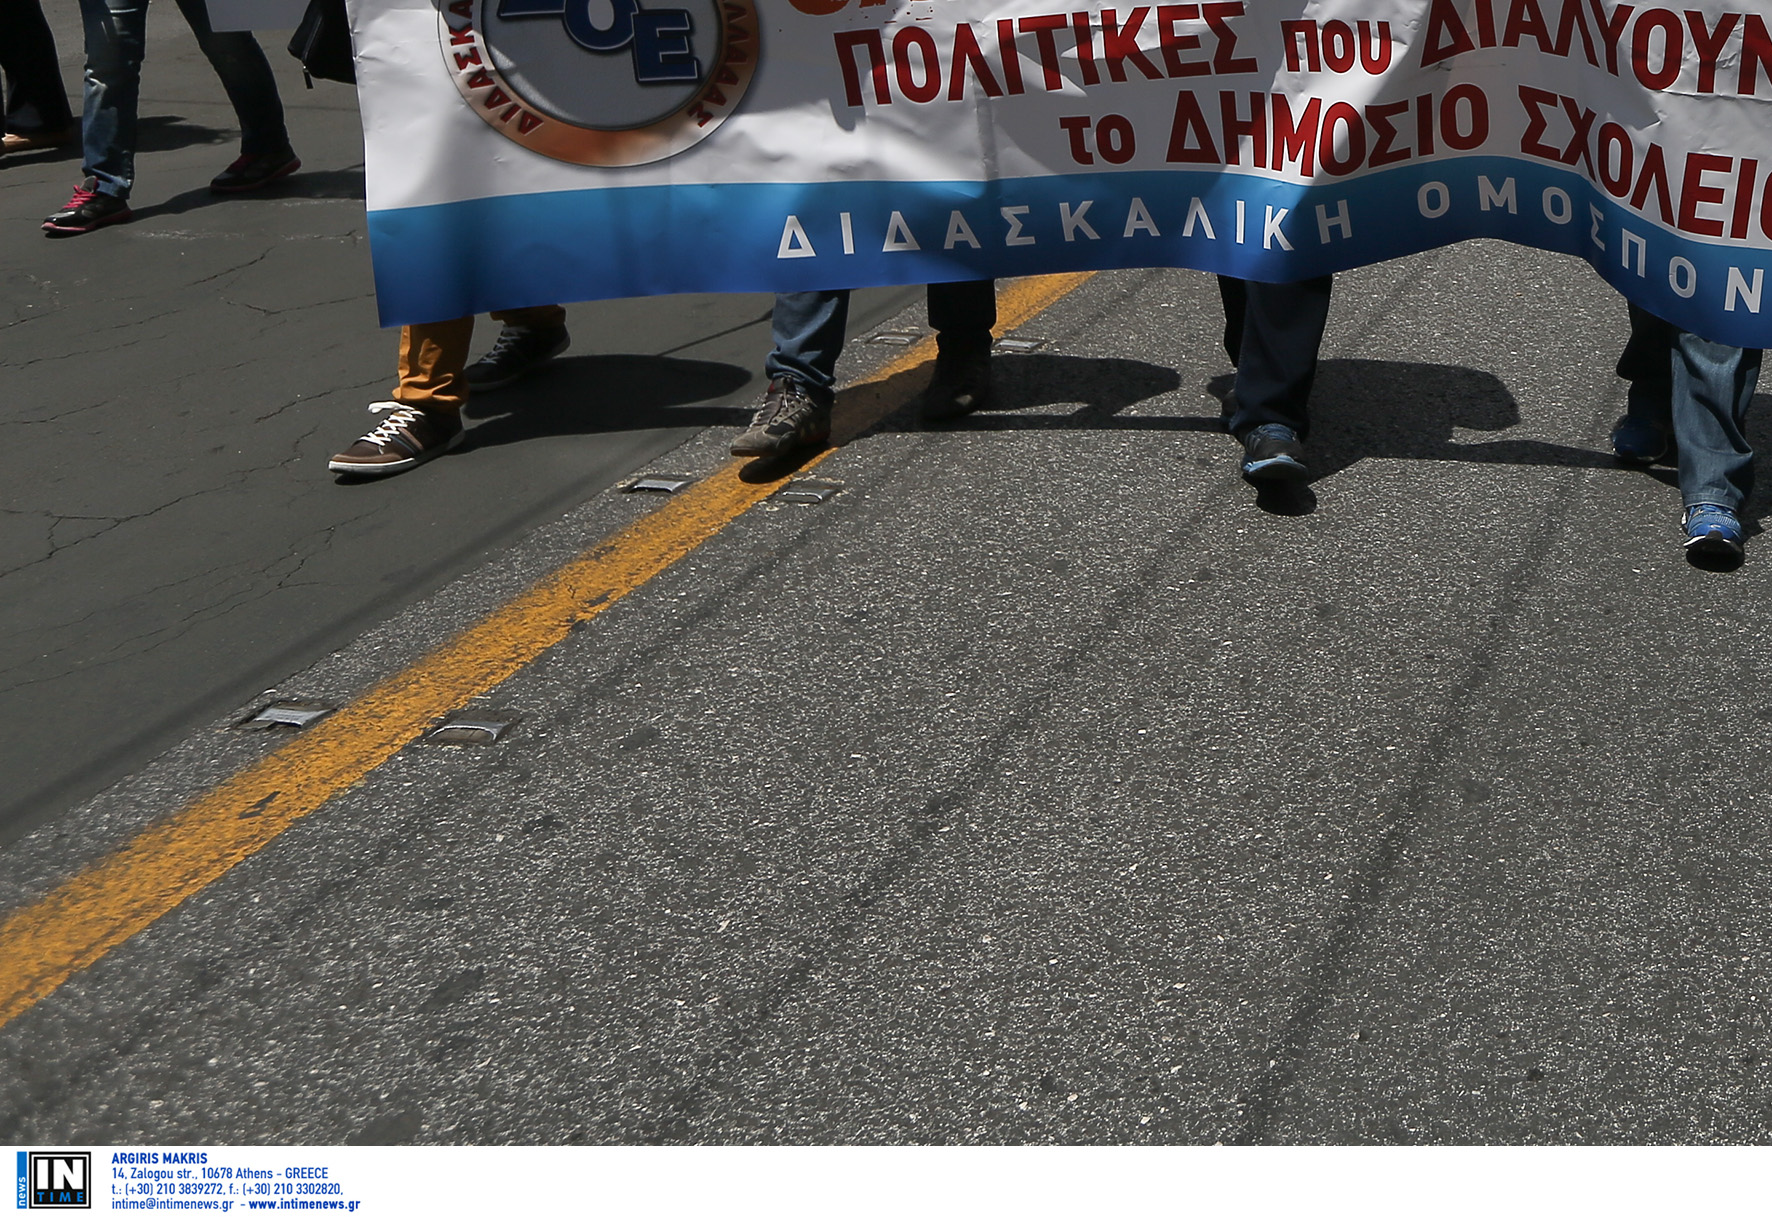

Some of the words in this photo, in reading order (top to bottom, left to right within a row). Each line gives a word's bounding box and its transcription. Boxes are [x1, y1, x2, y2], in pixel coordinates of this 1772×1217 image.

[834, 1, 1257, 107] ΠΟΛΙΤΙΚΕΣ
[1281, 18, 1393, 76] που
[1060, 114, 1136, 165] το
[1166, 83, 1490, 177] ΔΗΜΟΣΙΟ
[776, 195, 1352, 259] ΔΙΔΑΣΚΑΛΙΚΗ
